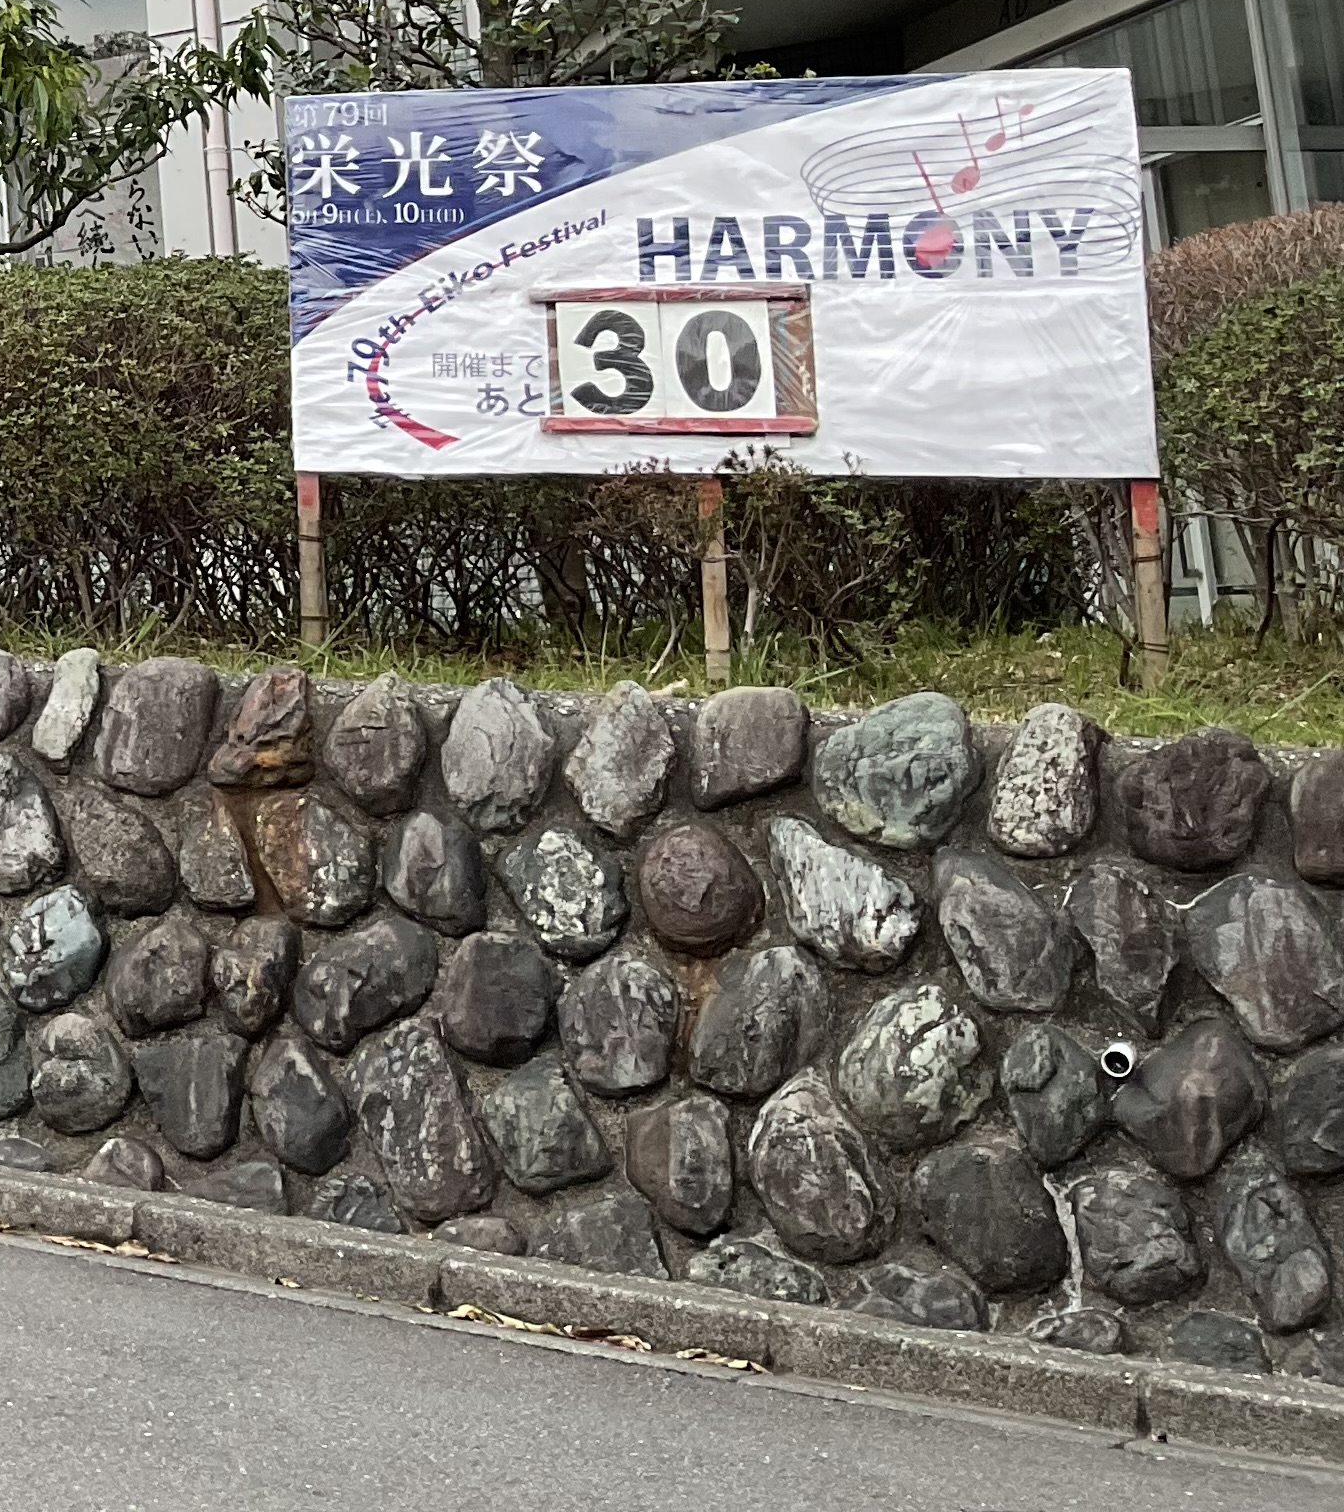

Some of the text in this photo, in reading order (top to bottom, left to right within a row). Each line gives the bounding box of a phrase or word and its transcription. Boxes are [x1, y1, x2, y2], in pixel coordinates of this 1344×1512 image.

[293, 101, 387, 127] 第79回
[291, 130, 543, 199] 栄光祭
[636, 208, 1095, 282] HARMONY
[347, 316, 416, 387] 79th
[418, 262, 494, 313] Eiko
[499, 209, 606, 268] Festival
[432, 352, 545, 379] 開催まで
[569, 310, 762, 416] 30
[476, 382, 546, 417] あと
